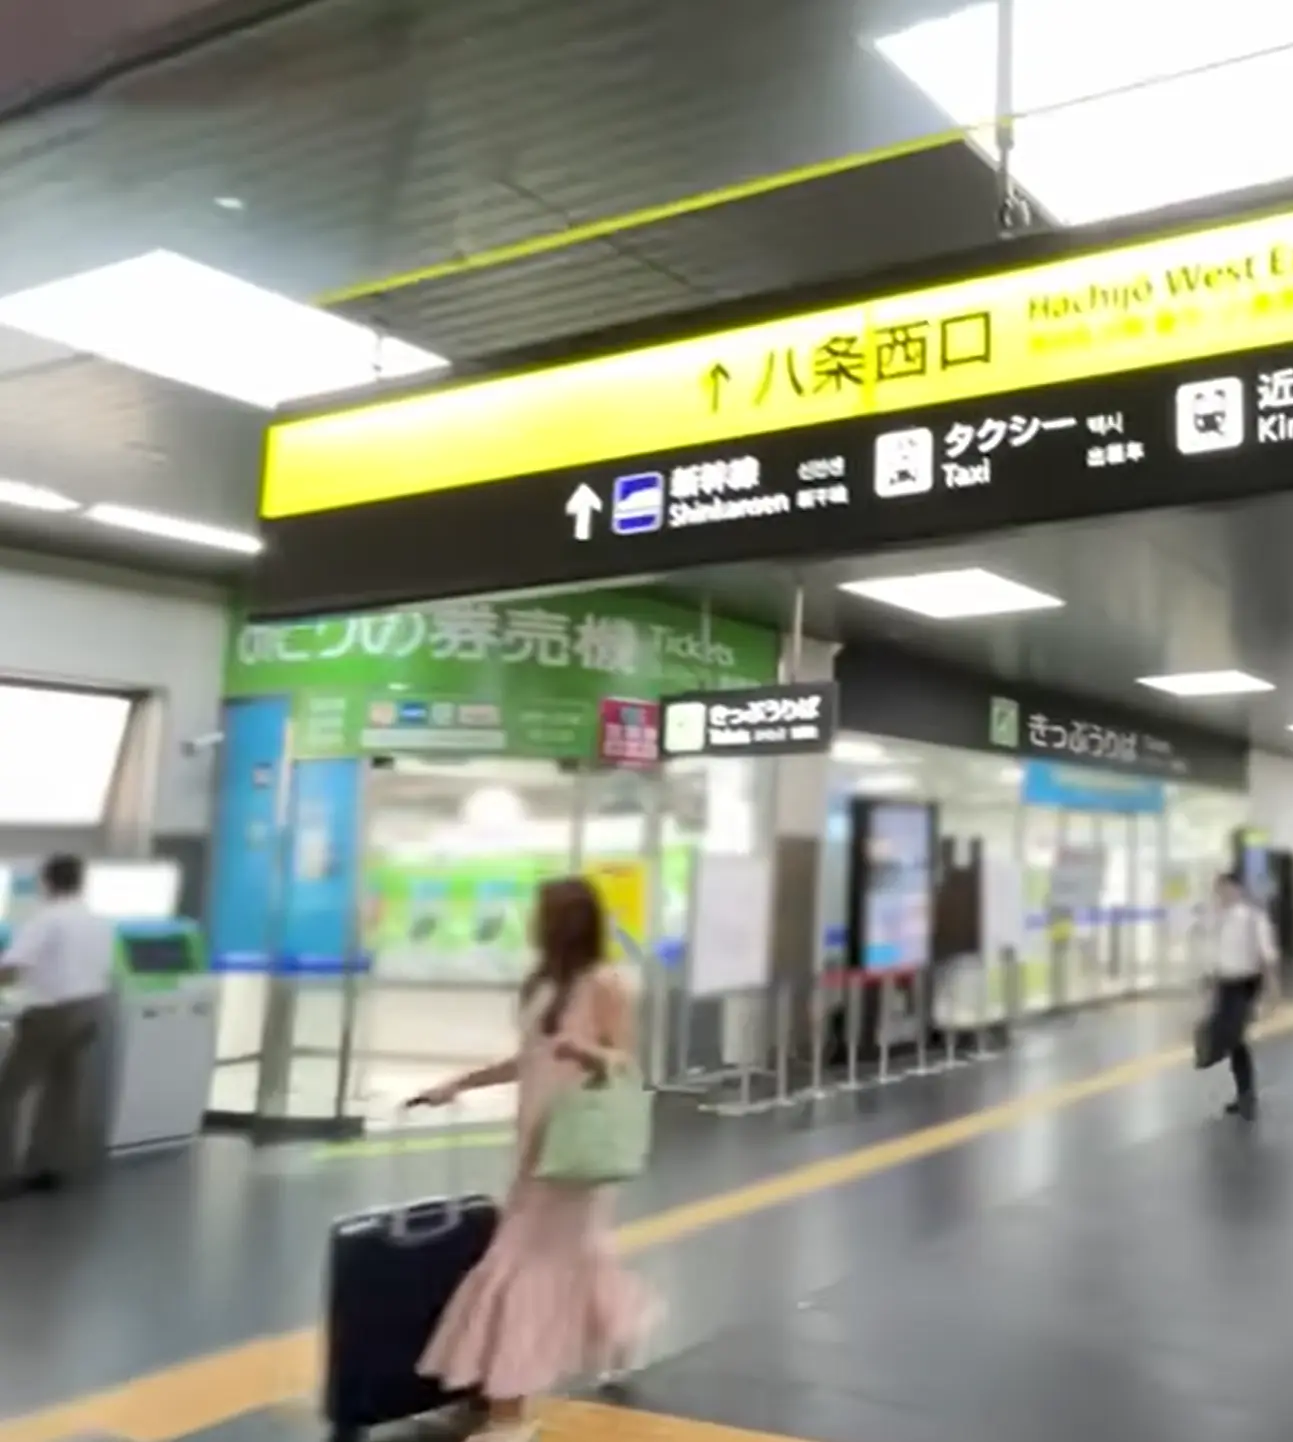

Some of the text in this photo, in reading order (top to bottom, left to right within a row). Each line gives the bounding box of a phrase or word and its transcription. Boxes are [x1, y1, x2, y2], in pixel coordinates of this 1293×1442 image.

[1166, 256, 1254, 297] West
[754, 312, 991, 405] 八条西口
[943, 414, 1077, 459] タクシー
[941, 455, 991, 489] Taxi
